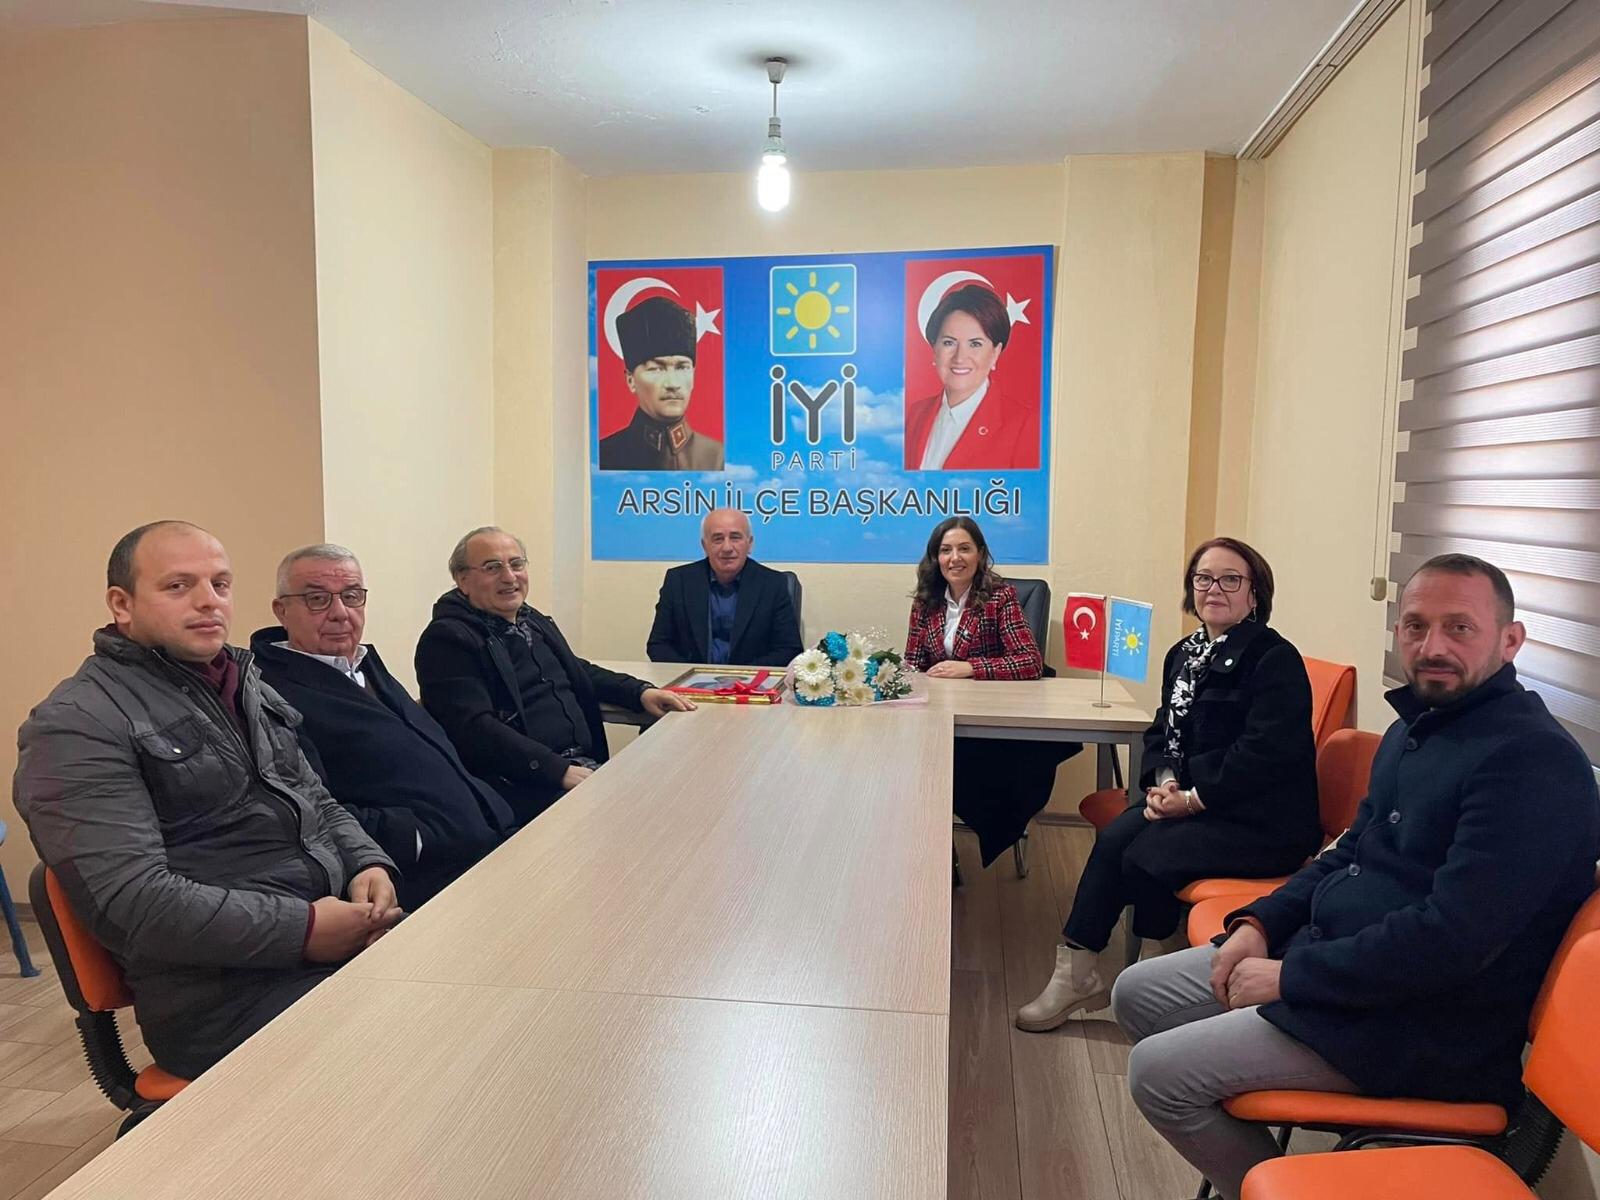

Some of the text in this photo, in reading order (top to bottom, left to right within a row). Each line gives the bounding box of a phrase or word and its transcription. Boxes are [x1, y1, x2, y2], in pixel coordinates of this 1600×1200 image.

[770, 363, 857, 446] İYİ
[771, 447, 857, 470] PARTİ
[617, 479, 1022, 524] ARSİN İLÇE BAŞKANLIĞI
